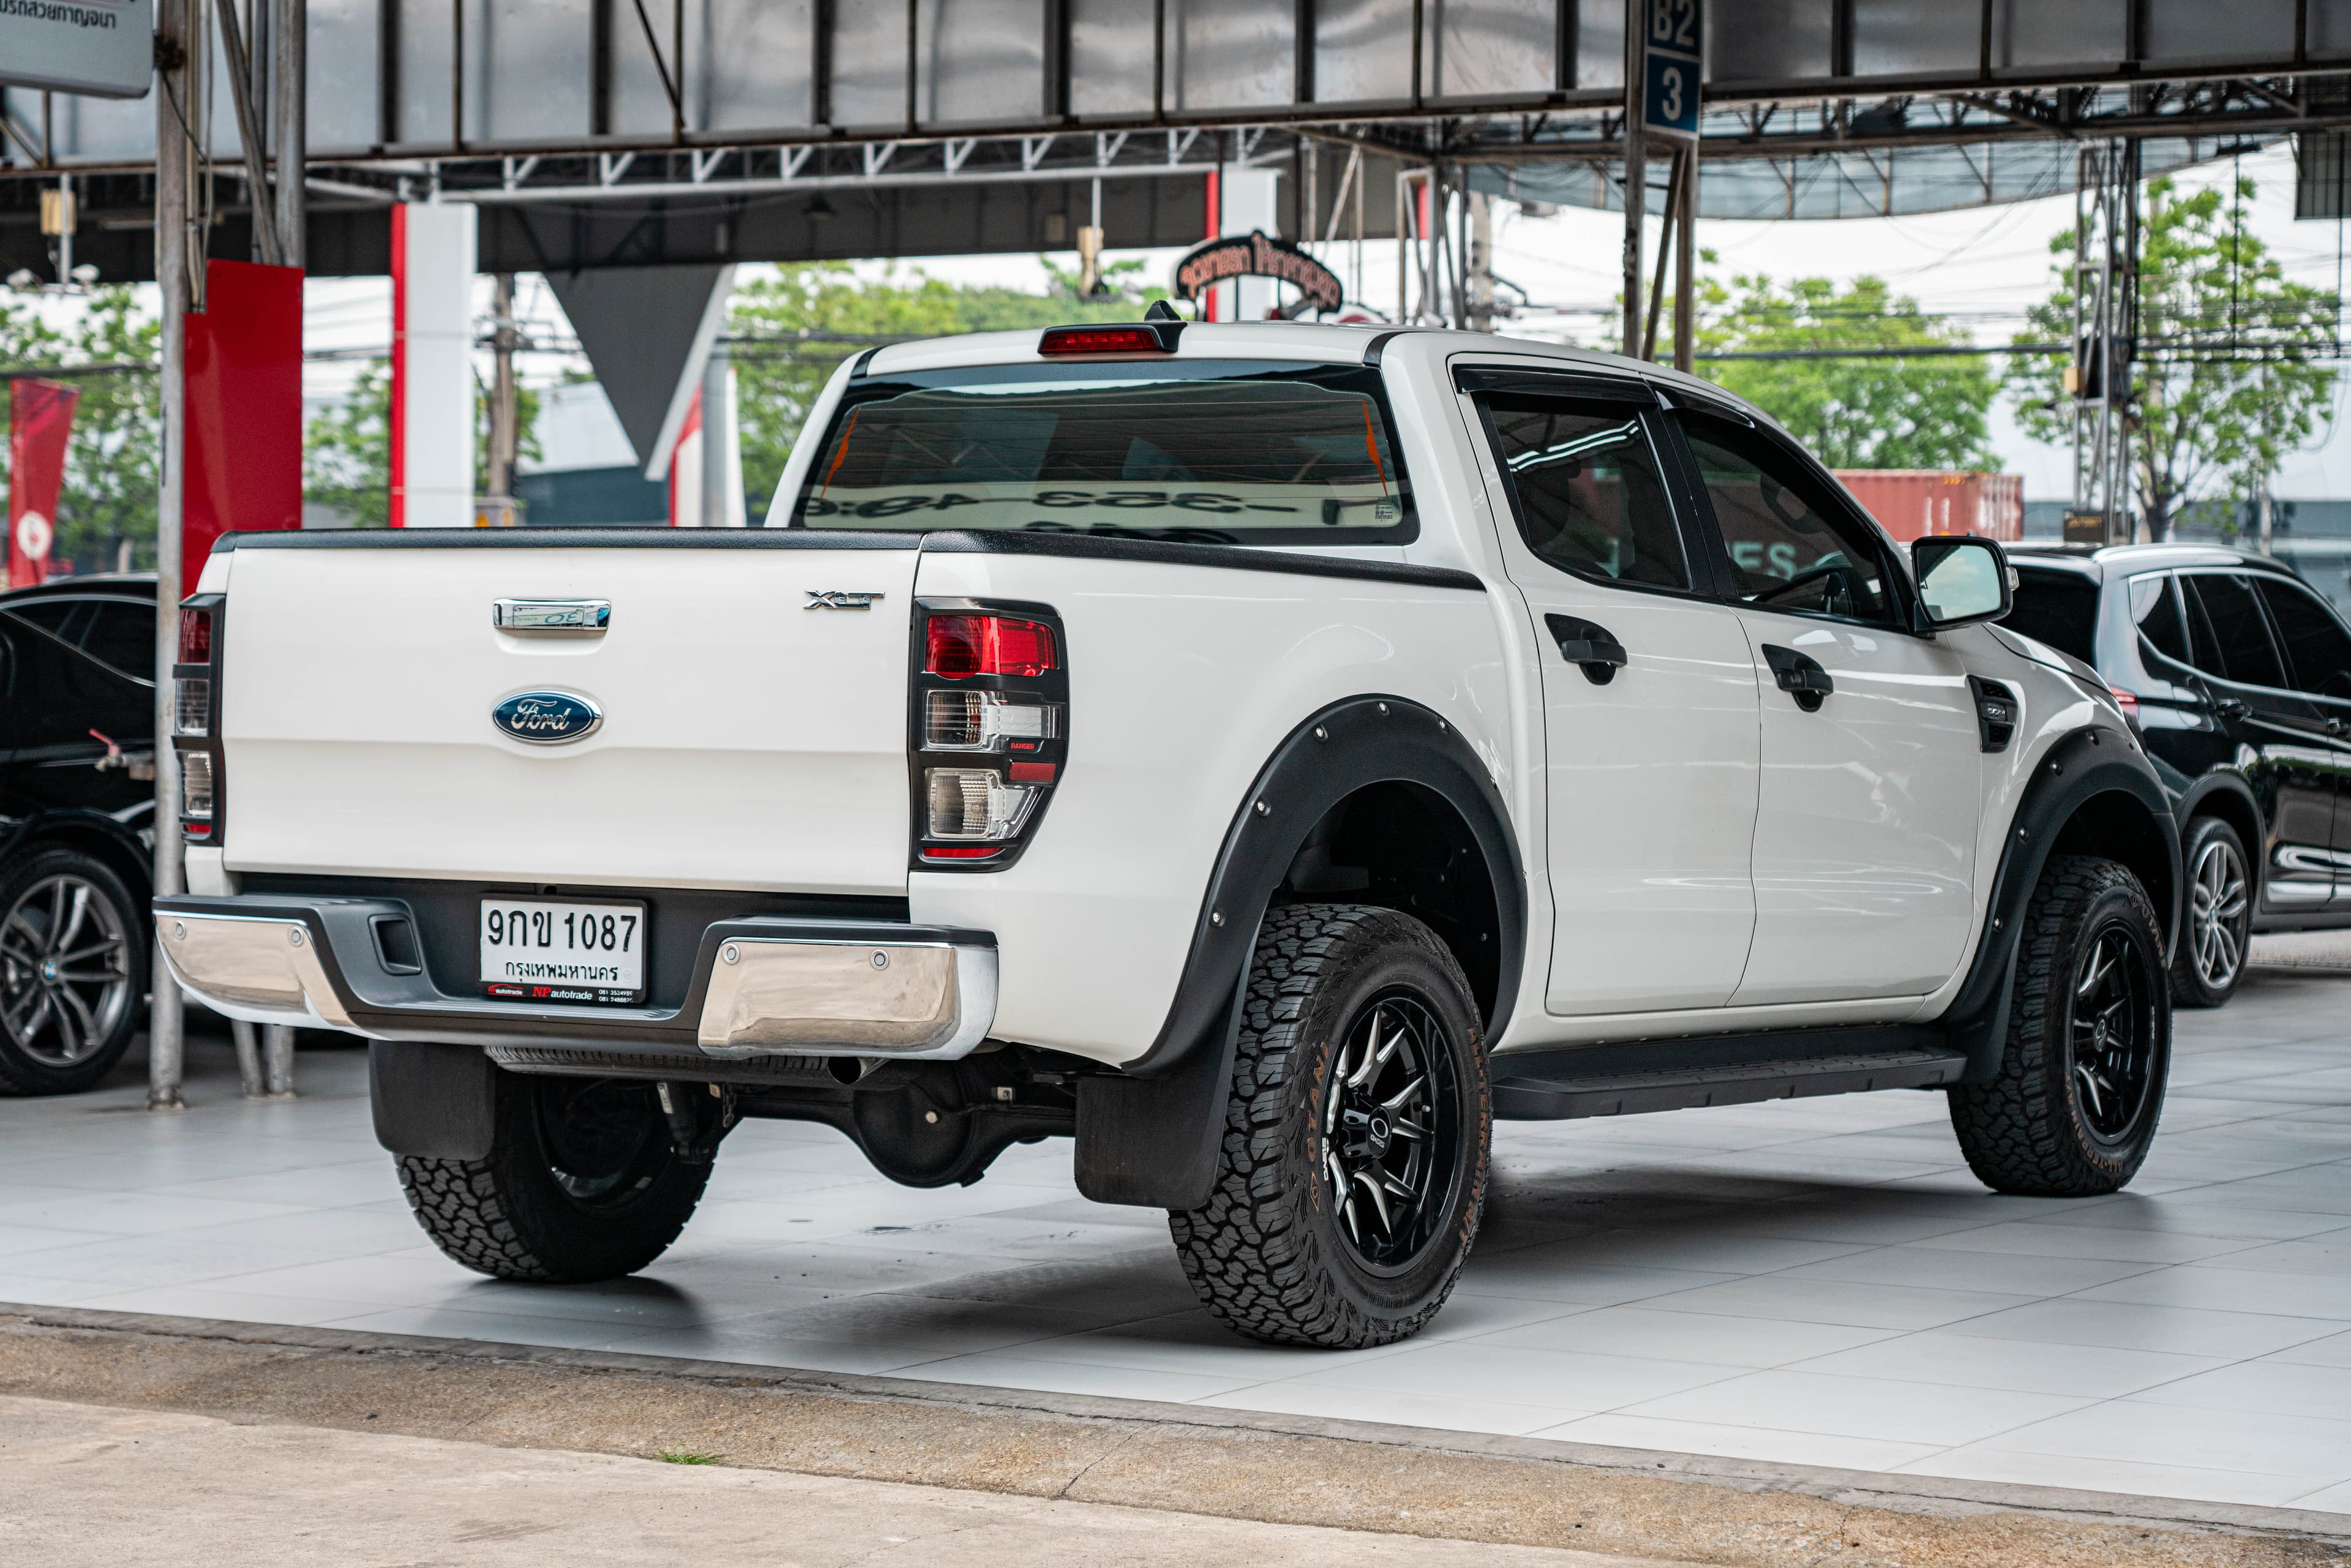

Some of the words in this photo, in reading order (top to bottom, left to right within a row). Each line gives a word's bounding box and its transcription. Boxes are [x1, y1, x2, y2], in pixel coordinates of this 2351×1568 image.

[1654, 0, 1695, 47] B2
[1662, 66, 1682, 121] 3
[803, 590, 885, 610] XLT
[511, 699, 572, 730] Ford
[488, 909, 552, 947] 9กข
[564, 912, 636, 952] 1087
[505, 961, 618, 982] กรุงเทพมหานคร
[1307, 1041, 1330, 1163] OTANI
